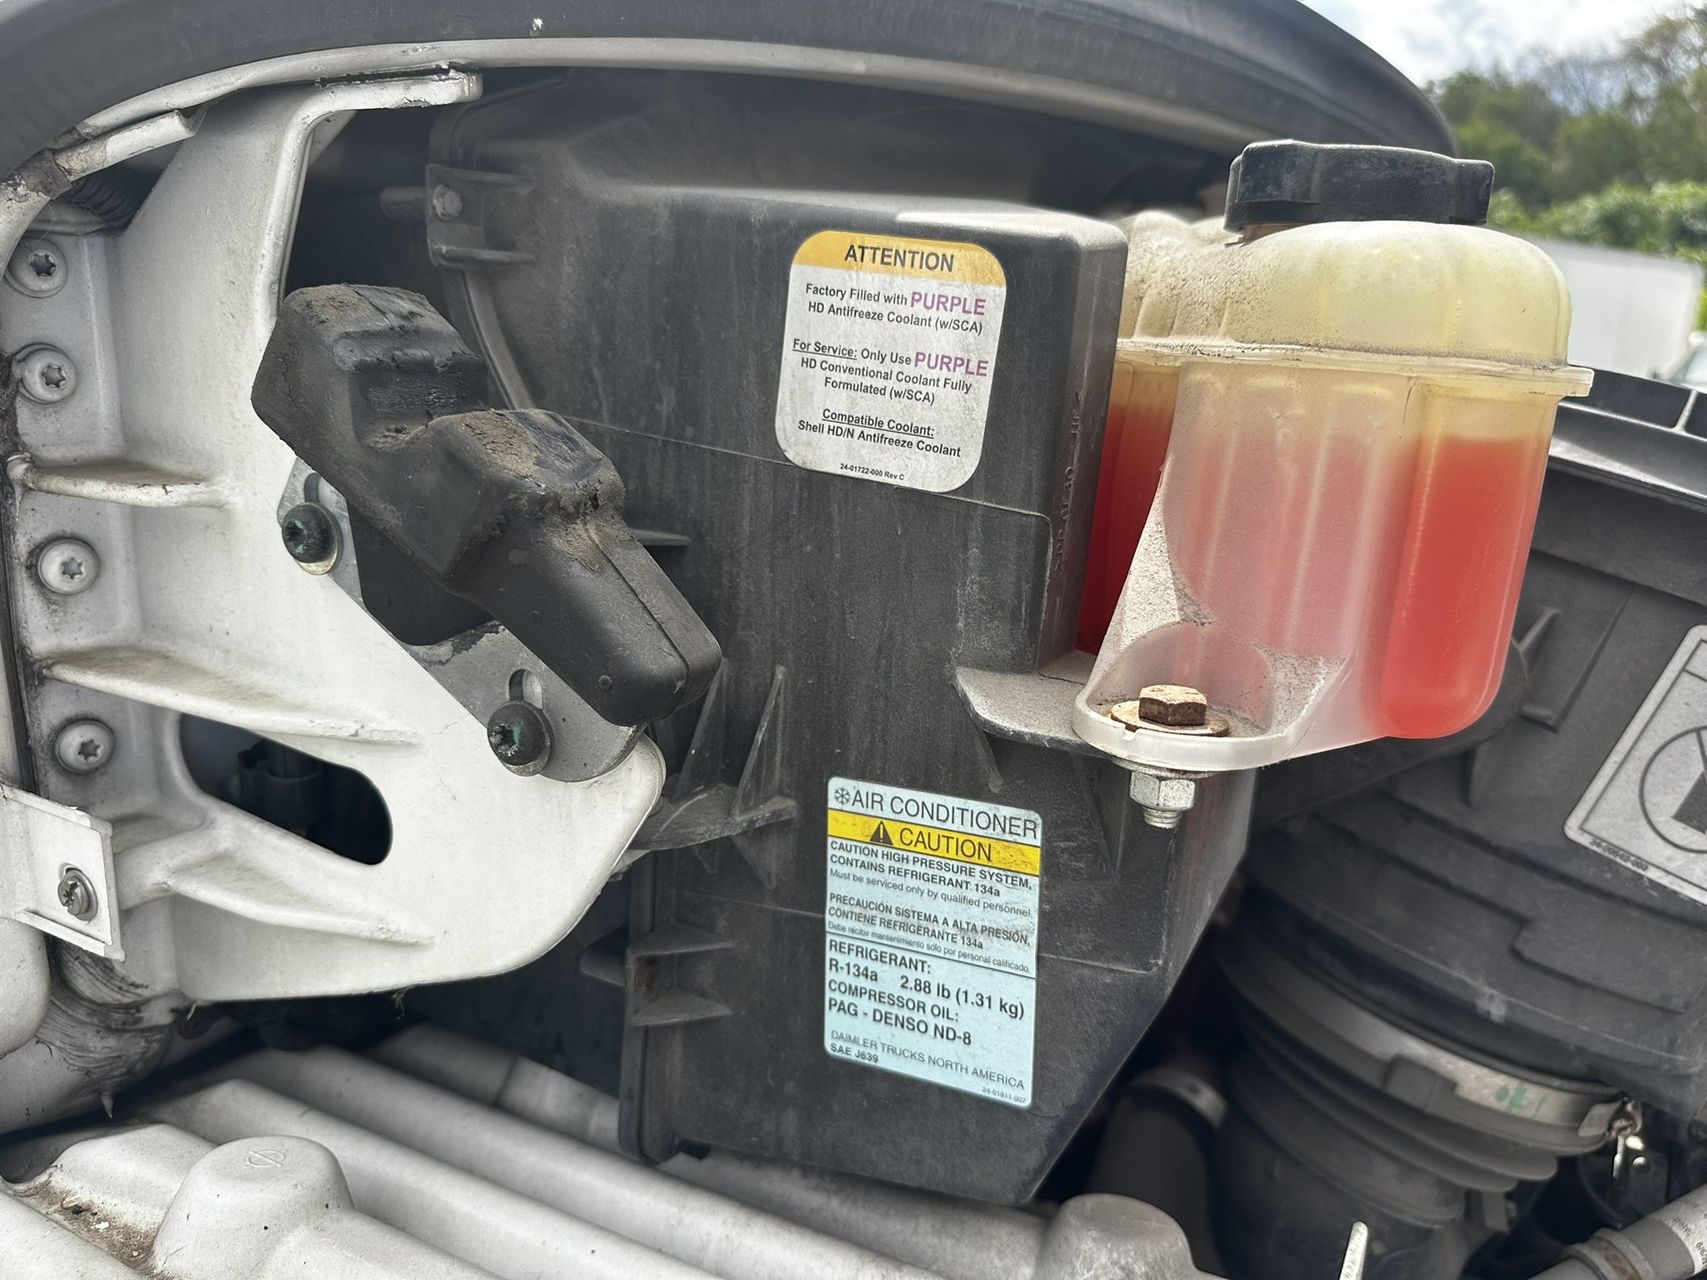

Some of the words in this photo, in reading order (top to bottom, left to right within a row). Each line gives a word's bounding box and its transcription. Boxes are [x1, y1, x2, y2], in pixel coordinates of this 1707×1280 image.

[845, 244, 954, 272] ATTENTION
[806, 283, 846, 300] Factory
[850, 289, 880, 302] Filled
[884, 292, 907, 305] with
[911, 292, 986, 315] PURPLE
[808, 301, 824, 313] HD
[828, 304, 883, 321] Antifreeze
[887, 311, 932, 328] Coolant
[935, 317, 982, 335] (w/SCA)
[793, 339, 811, 352] For
[813, 341, 857, 358] Service:
[861, 348, 887, 363] Only
[890, 352, 911, 365] Use
[914, 352, 988, 377] PURPLE
[801, 357, 816, 369] HD
[820, 360, 892, 380] Conventional
[896, 371, 940, 387] Coolant
[943, 378, 972, 394] Fully
[824, 377, 886, 396] Formulated
[890, 388, 935, 405] (w/SCA)
[798, 420, 824, 434] Shell
[827, 425, 855, 440] HD/N
[858, 430, 913, 449] Antifreeze
[916, 440, 961, 458] Coolant
[822, 408, 884, 428] Compatible
[887, 419, 934, 437] Coolant:
[840, 463, 883, 478] 24-01722-000
[884, 470, 897, 479] Rev
[899, 473, 905, 481] C
[852, 790, 883, 811] AIR
[891, 796, 1038, 839] CONDITIONER
[900, 827, 992, 862] CAUTION
[830, 854, 885, 873] CONTAINS
[974, 883, 1001, 897] 134a
[831, 841, 881, 858] CAUTION
[882, 848, 909, 865] HIGH
[913, 857, 975, 877] PRESSURE
[979, 869, 1032, 890] SYSTEM,
[830, 868, 850, 882] Must
[853, 872, 864, 883] be
[866, 876, 904, 892] serviced
[906, 884, 924, 897] only
[928, 888, 938, 900] by
[941, 891, 980, 909] qualified
[982, 900, 1033, 918] personnel.
[829, 907, 877, 926] CONTIENE
[879, 918, 958, 944] REFRIGERANTE
[961, 936, 983, 949] 134a
[830, 893, 892, 914] PRECAUCIÓN
[895, 907, 939, 924] SISTEMA
[942, 916, 949, 926] A
[952, 919, 978, 934] ALTA
[828, 921, 846, 932] Debe
[871, 931, 924, 949] mantenimiento
[943, 947, 956, 958] por
[958, 951, 991, 965] personal
[829, 939, 932, 974] REFRIGERANT:
[829, 959, 878, 982] R-134a
[900, 975, 931, 994] 2.88
[937, 983, 950, 999] lb
[956, 987, 992, 1010] (1.31
[1000, 998, 1024, 1020] kg)
[829, 979, 926, 1014] COMPRESSOR
[930, 1004, 959, 1022] OIL:
[829, 998, 858, 1017] PAG
[873, 1009, 928, 1034] DENSO
[934, 1023, 971, 1046] ND-8
[830, 1043, 852, 1056] SAE
[855, 1050, 879, 1064] J639
[831, 1030, 878, 1050] DAIMLER
[879, 1042, 925, 1062] TRUCKS
[928, 1055, 969, 1074] NORTH
[971, 1067, 1024, 1089] AMERICA
